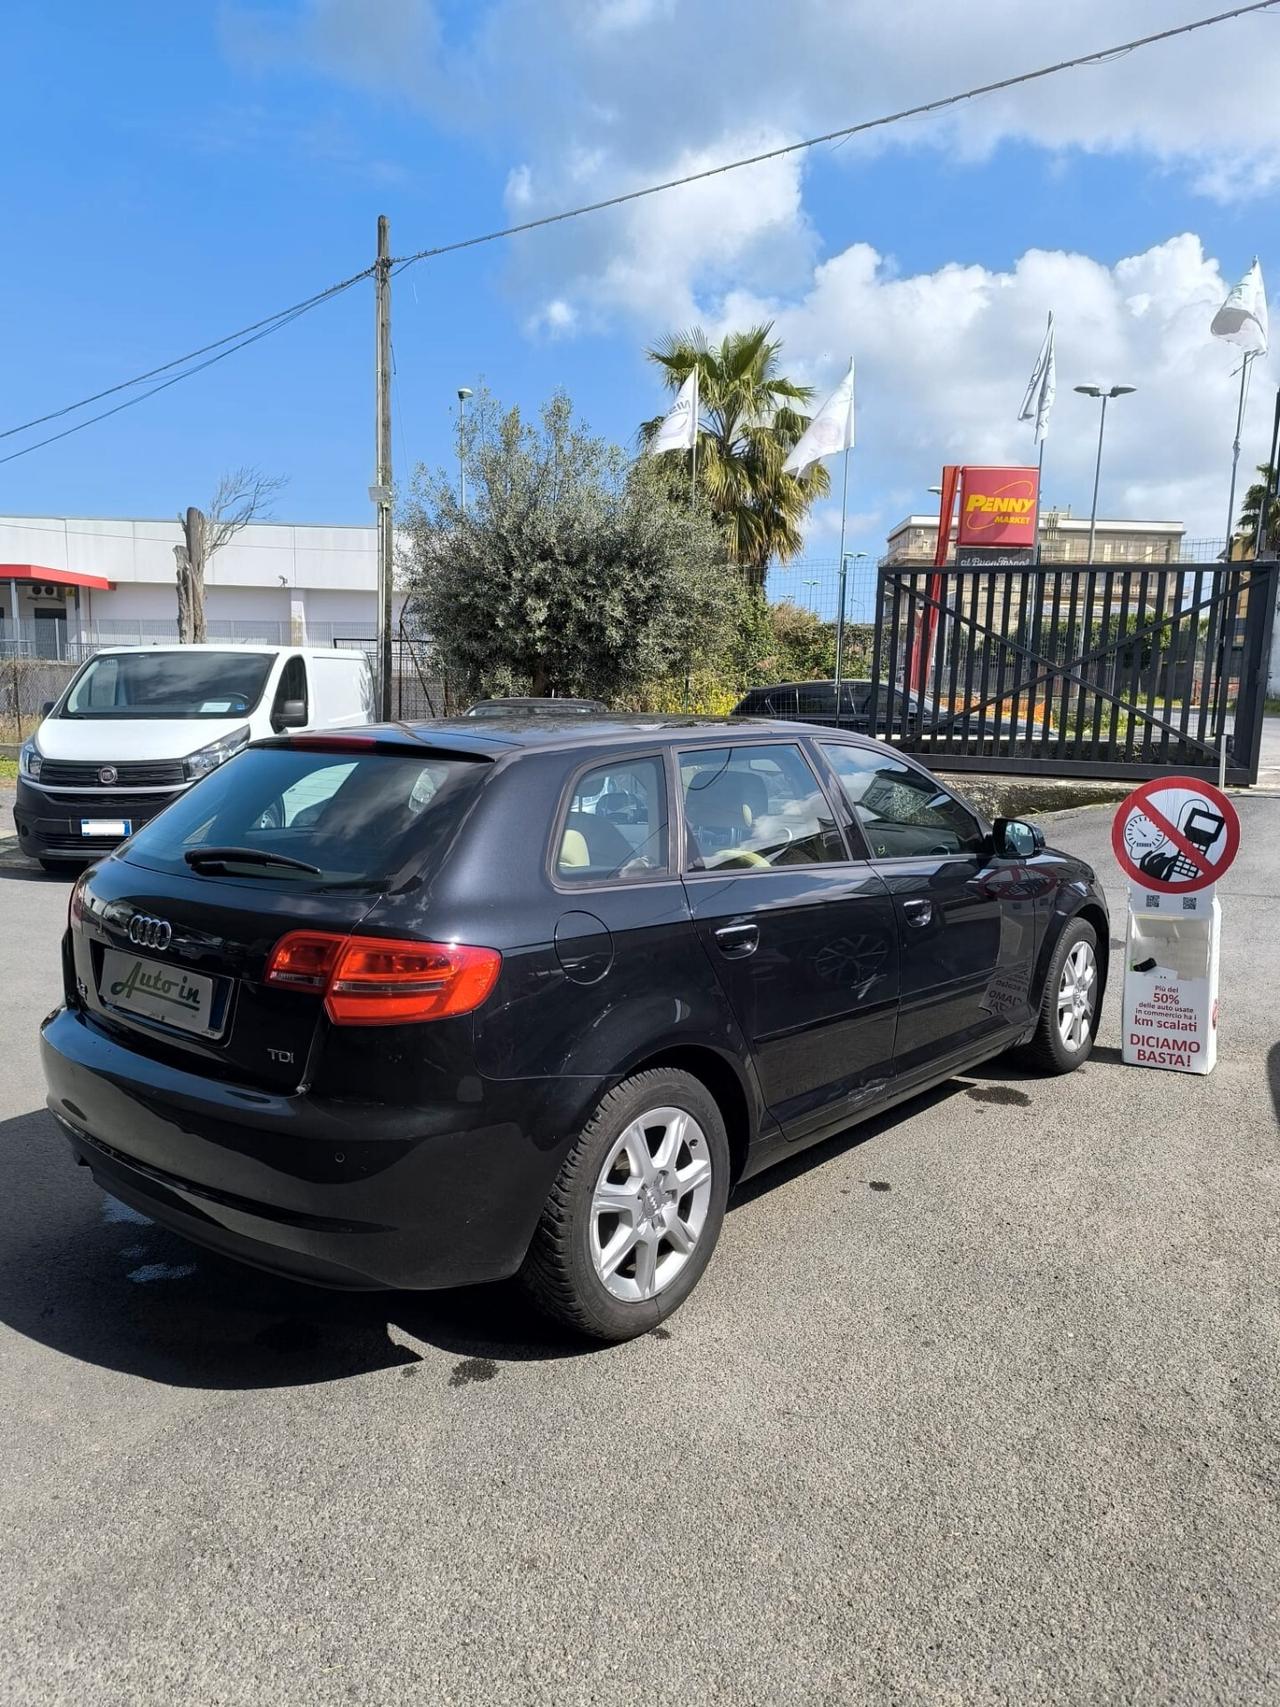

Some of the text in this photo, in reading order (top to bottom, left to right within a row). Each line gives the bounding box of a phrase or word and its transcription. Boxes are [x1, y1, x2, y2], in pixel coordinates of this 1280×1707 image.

[966, 494, 1035, 513] PENNY
[994, 516, 1030, 525] MARKET
[1153, 993, 1180, 1005] 50%
[1144, 1009, 1182, 1019] commercio
[1157, 1004, 1173, 1012] auto
[1134, 1015, 1197, 1032] km scalati
[1130, 1033, 1200, 1053] DICIAMO
[267, 1048, 294, 1064] TDI
[1137, 1049, 1191, 1067] BASTA!
